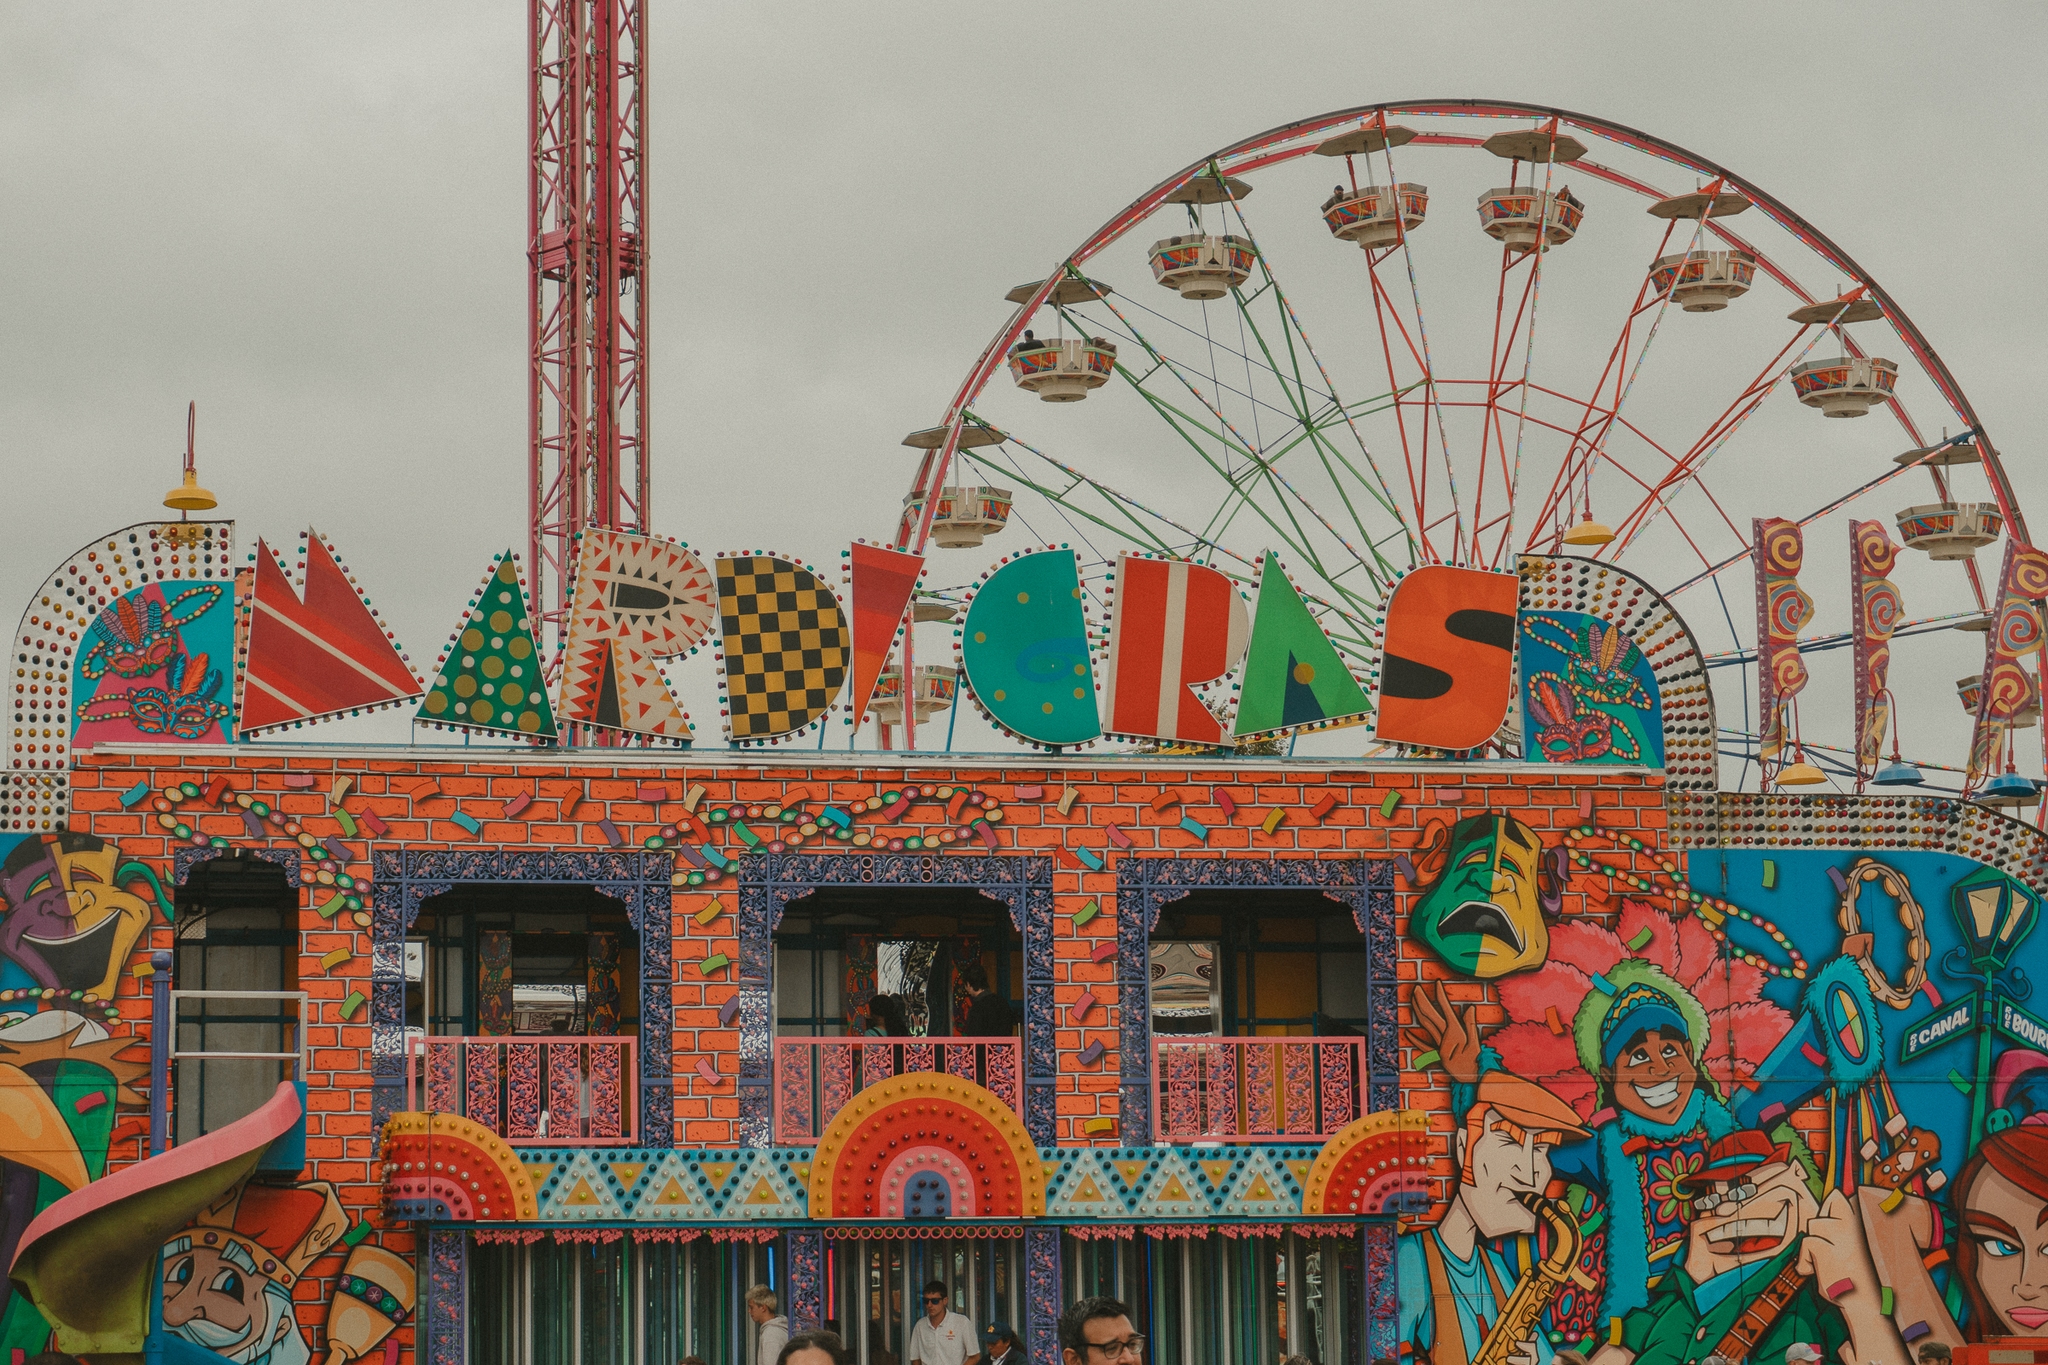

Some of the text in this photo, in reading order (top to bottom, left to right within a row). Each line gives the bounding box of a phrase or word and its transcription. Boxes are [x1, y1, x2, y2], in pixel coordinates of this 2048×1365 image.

[240, 525, 1520, 750] MARDI GRAS
[1918, 1007, 1970, 1044] CANAL
[2004, 1005, 2048, 1050] RUE BOUR
